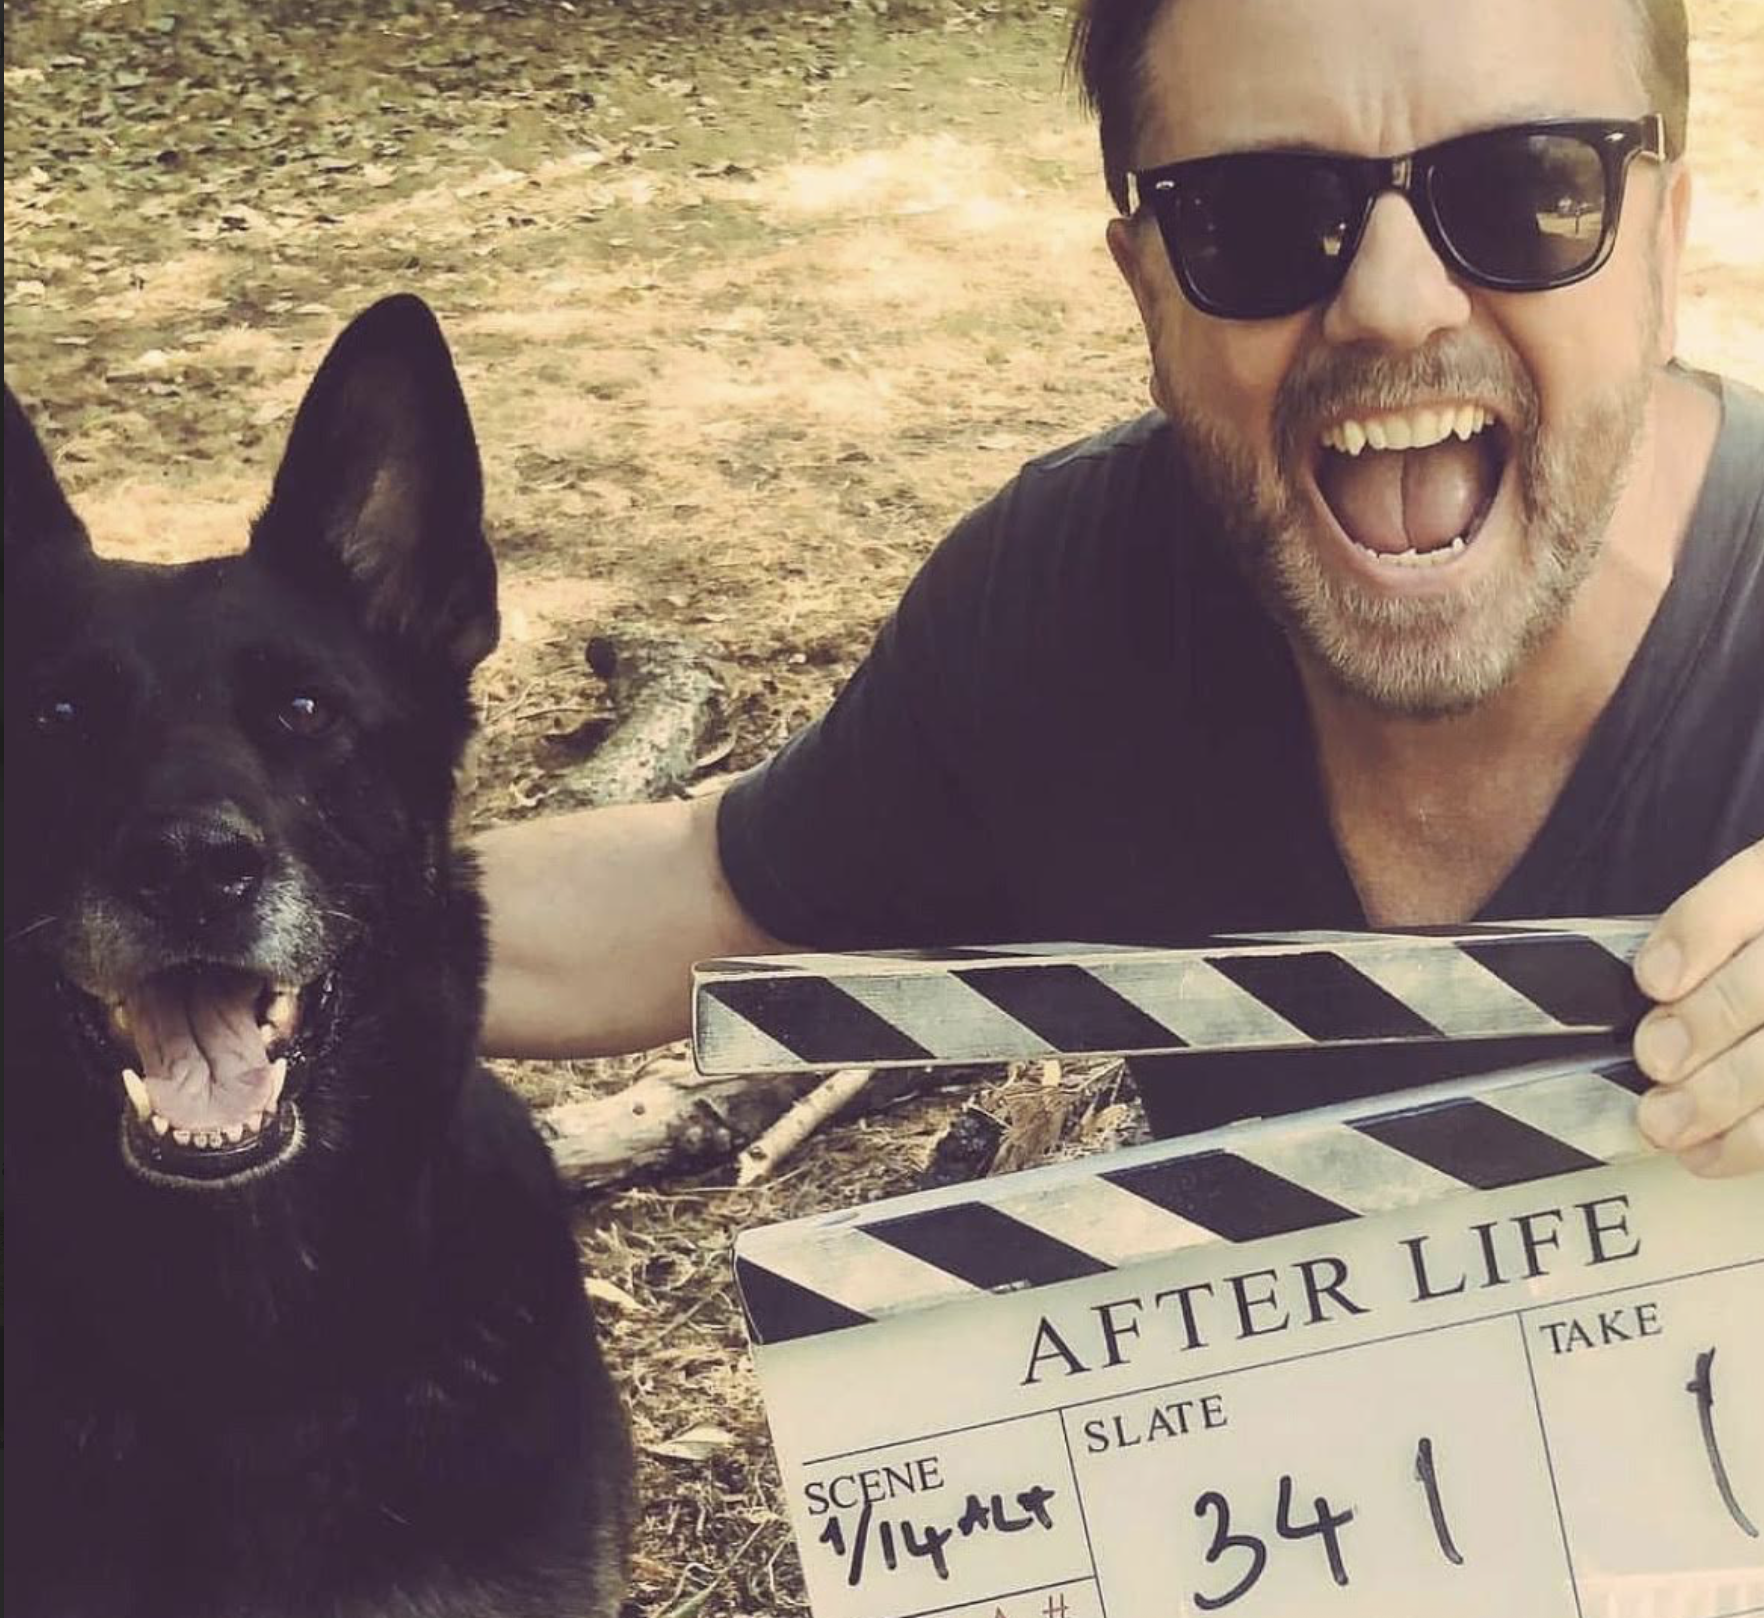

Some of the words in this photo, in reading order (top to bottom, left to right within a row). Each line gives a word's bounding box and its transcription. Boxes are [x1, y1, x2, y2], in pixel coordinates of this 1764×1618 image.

[1020, 1257, 1372, 1386] AFTER
[1398, 1195, 1642, 1303] LIFE
[1539, 1303, 1663, 1355] TAKE
[1084, 1395, 1228, 1453] SLATE
[804, 1457, 945, 1516] SCENE
